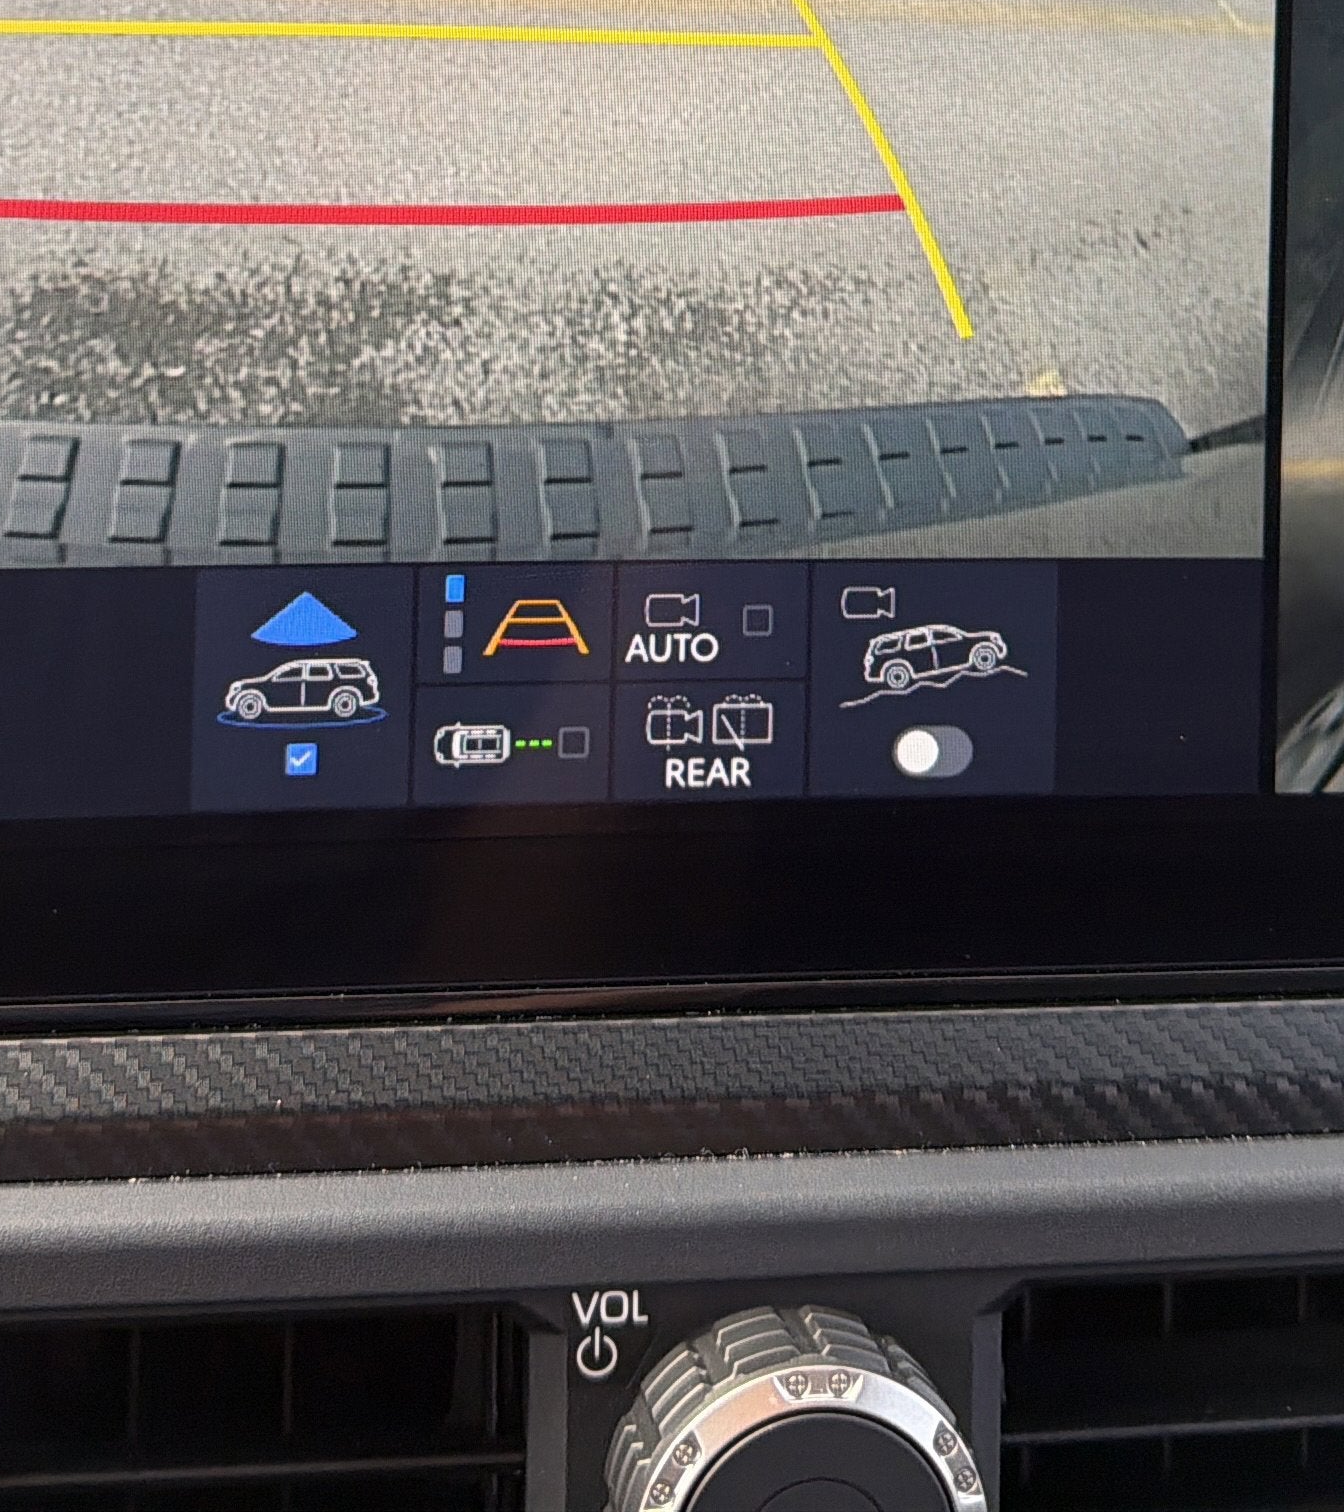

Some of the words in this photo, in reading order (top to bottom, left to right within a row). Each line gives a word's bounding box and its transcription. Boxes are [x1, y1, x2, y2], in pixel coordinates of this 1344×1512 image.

[624, 633, 719, 663] AUTO
[665, 757, 752, 788] REAR
[571, 1289, 649, 1325] VOL
